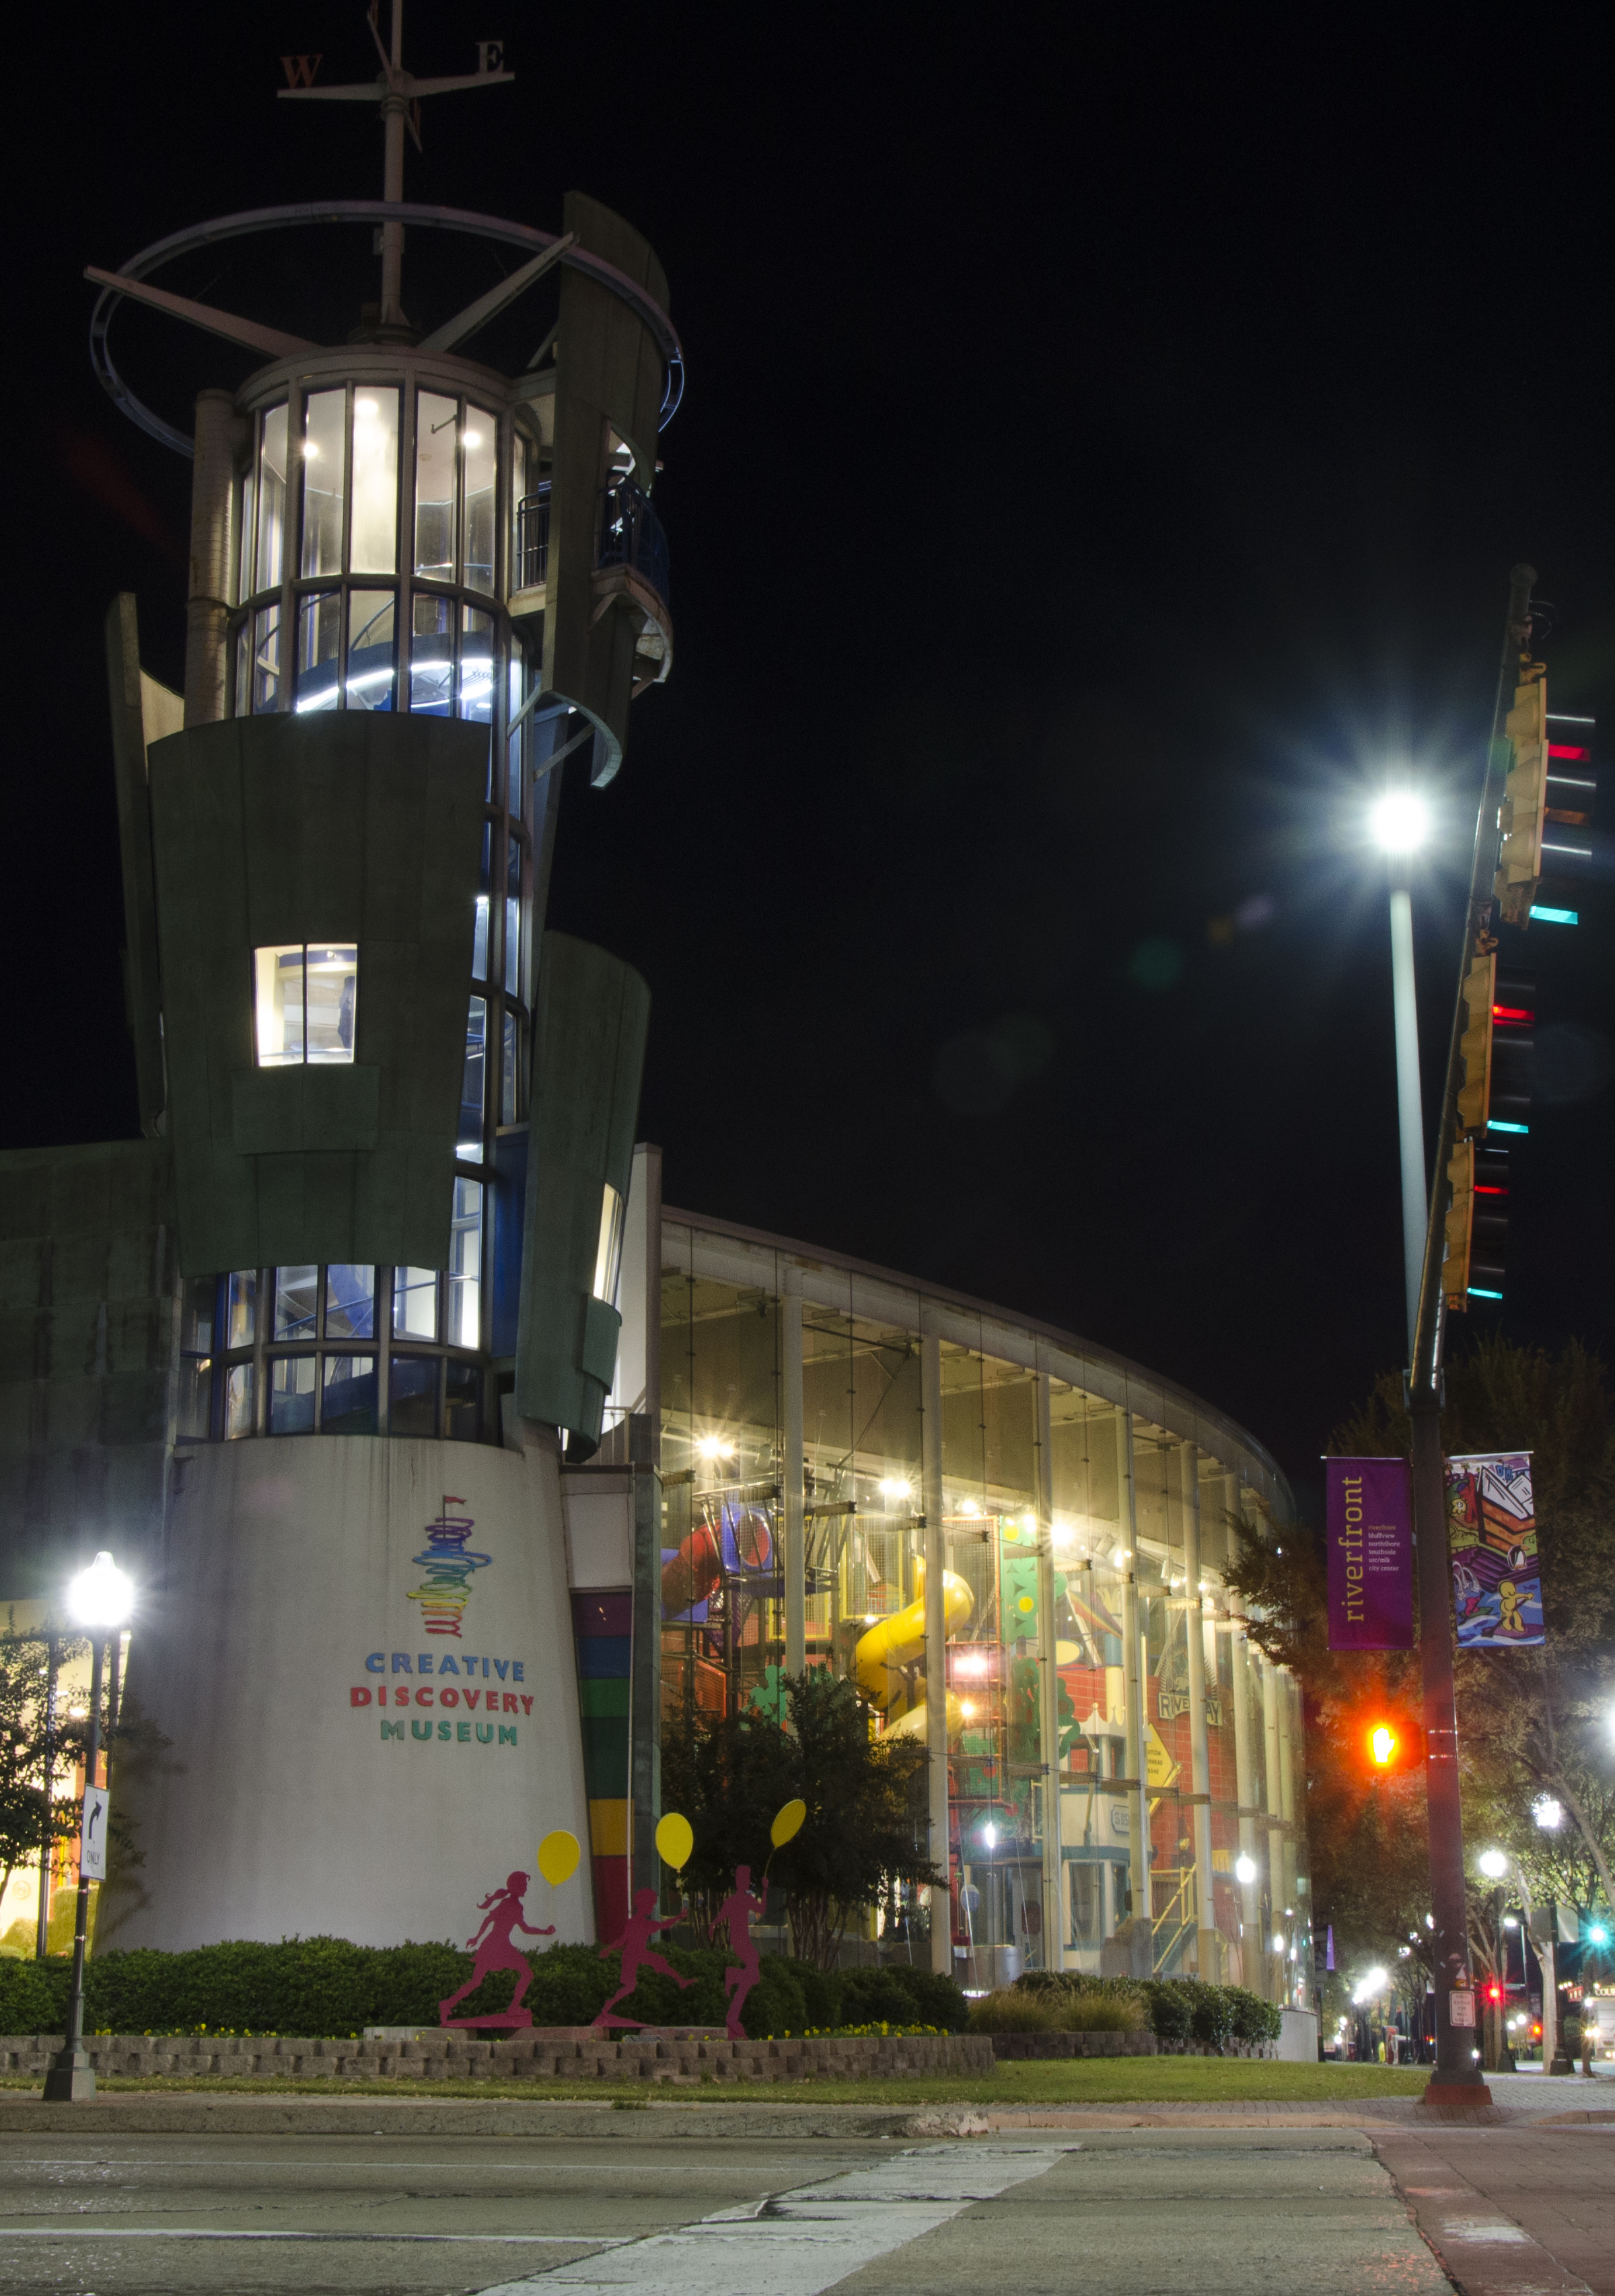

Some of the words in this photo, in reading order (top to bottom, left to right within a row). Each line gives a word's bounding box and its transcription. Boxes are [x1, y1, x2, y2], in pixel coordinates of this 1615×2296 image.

[280, 54, 323, 89] W
[476, 40, 504, 73] E
[1338, 1476, 1364, 1622] riverfront
[365, 1652, 525, 1682] CREATIVE
[350, 1686, 535, 1715] DISCOVERY
[380, 1719, 517, 1746] MUSEUM
[87, 1850, 100, 1865] ONLY
